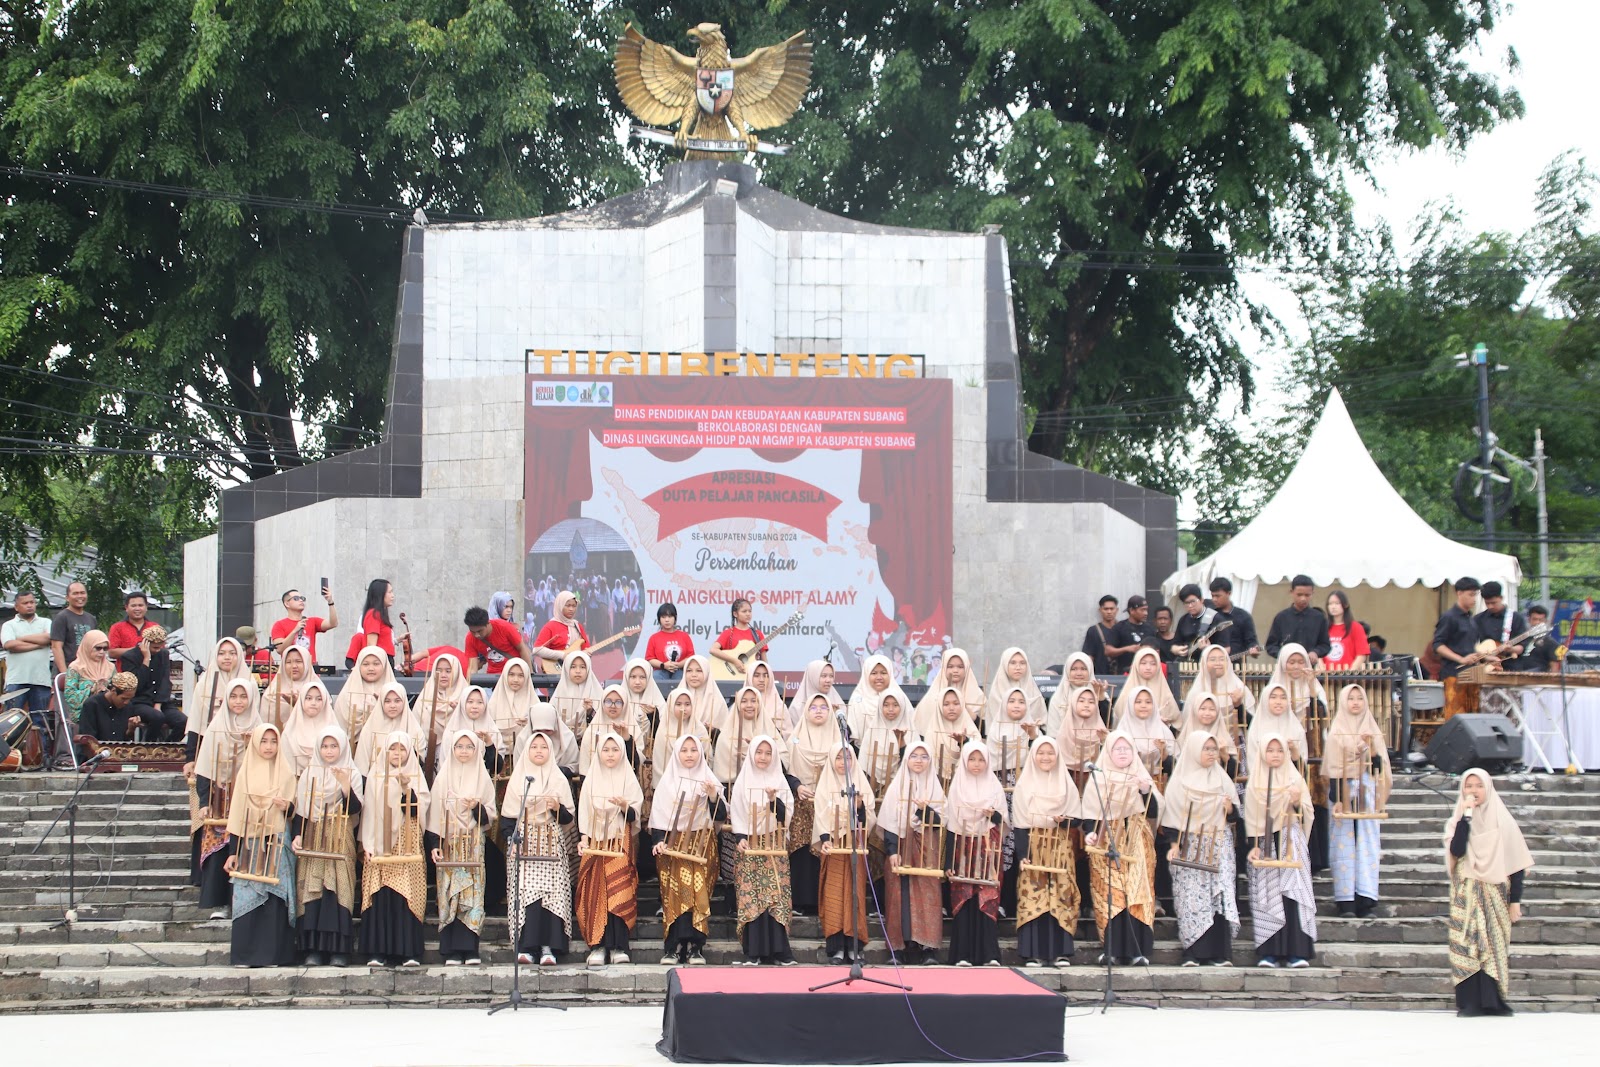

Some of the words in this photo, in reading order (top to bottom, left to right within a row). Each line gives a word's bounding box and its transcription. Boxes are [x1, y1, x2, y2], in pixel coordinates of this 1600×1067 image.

[534, 350, 668, 375] TUGU
[681, 352, 916, 378] BENTENG
[615, 408, 646, 419] DINAS
[648, 409, 709, 420] PENDIDIKAN
[711, 410, 733, 420] DAN
[736, 410, 801, 421] KEBUDAYAAN
[804, 410, 861, 421] KABUPATEN
[864, 411, 905, 422] SUBANG
[697, 422, 778, 433] BERKOLABORASI
[780, 423, 822, 433] DENGAN
[603, 433, 634, 444] DINAS
[636, 434, 703, 445] LINGKUNGAN
[705, 434, 736, 445] HIDUP
[738, 435, 760, 446] DAN
[762, 435, 795, 446] MGMP
[796, 435, 813, 446] IPA
[815, 436, 872, 446] KABUPATEN
[874, 436, 916, 447] SUBANG
[711, 471, 776, 485] APRESIASI
[662, 489, 697, 502] DUTA
[700, 489, 754, 503] PELAJAR
[758, 490, 826, 503] PANCASILA
[691, 532, 746, 541] SE-KABUPATEN
[748, 532, 779, 541] SUBANG
[780, 532, 798, 541] 2024
[694, 547, 798, 572] Persembahan
[647, 589, 673, 604] TIM
[676, 589, 756, 605] ANGKLUNG
[759, 590, 804, 605] SMPIT
[806, 590, 858, 606] ALAMY
